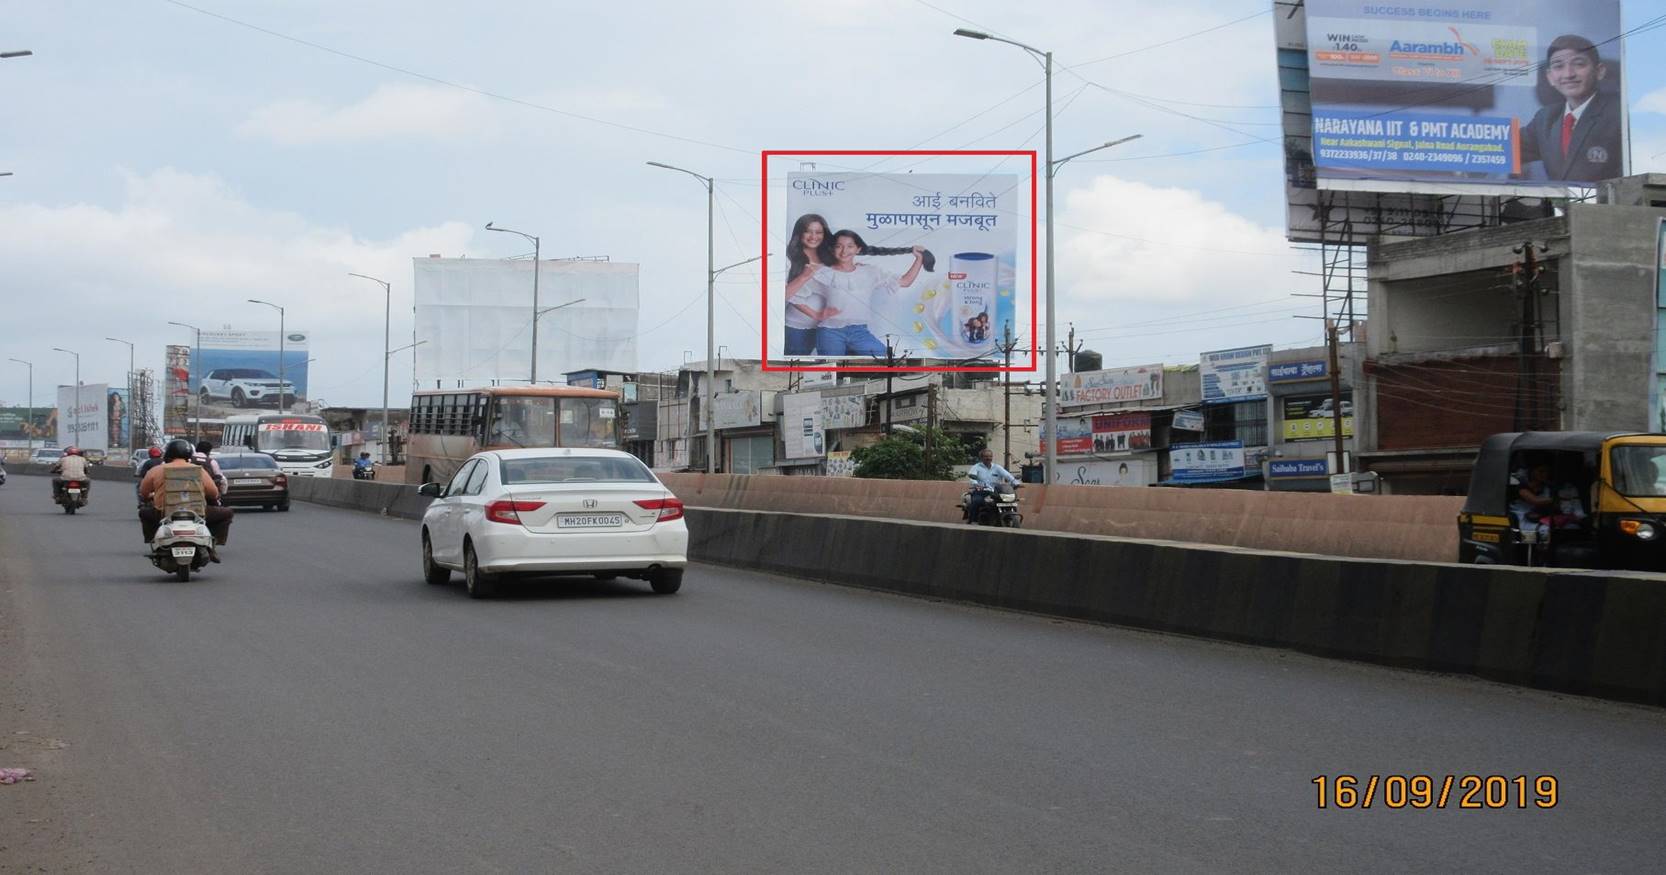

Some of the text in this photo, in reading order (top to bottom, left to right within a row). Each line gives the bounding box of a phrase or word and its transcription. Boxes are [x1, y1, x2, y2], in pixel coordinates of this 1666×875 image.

[1364, 6, 1492, 20] SUCCESS BEGINS HERE
[1327, 33, 1351, 42] WIN
[1390, 40, 1465, 55] Aarambh
[1315, 117, 1511, 140] NARAYANA IIT & PMT ACADEMY
[1320, 137, 1338, 146] Near
[792, 178, 845, 191] CLINIC
[912, 191, 997, 210] आई बनविते
[865, 213, 997, 232] मुळापासून मजबूत
[957, 281, 991, 289] CLINIC
[1076, 384, 1143, 402] FACTORY OUTLET
[266, 424, 322, 432] ISHANI
[1271, 462, 1324, 473] Saibaba Travel's
[564, 516, 621, 526] MH20FK0045
